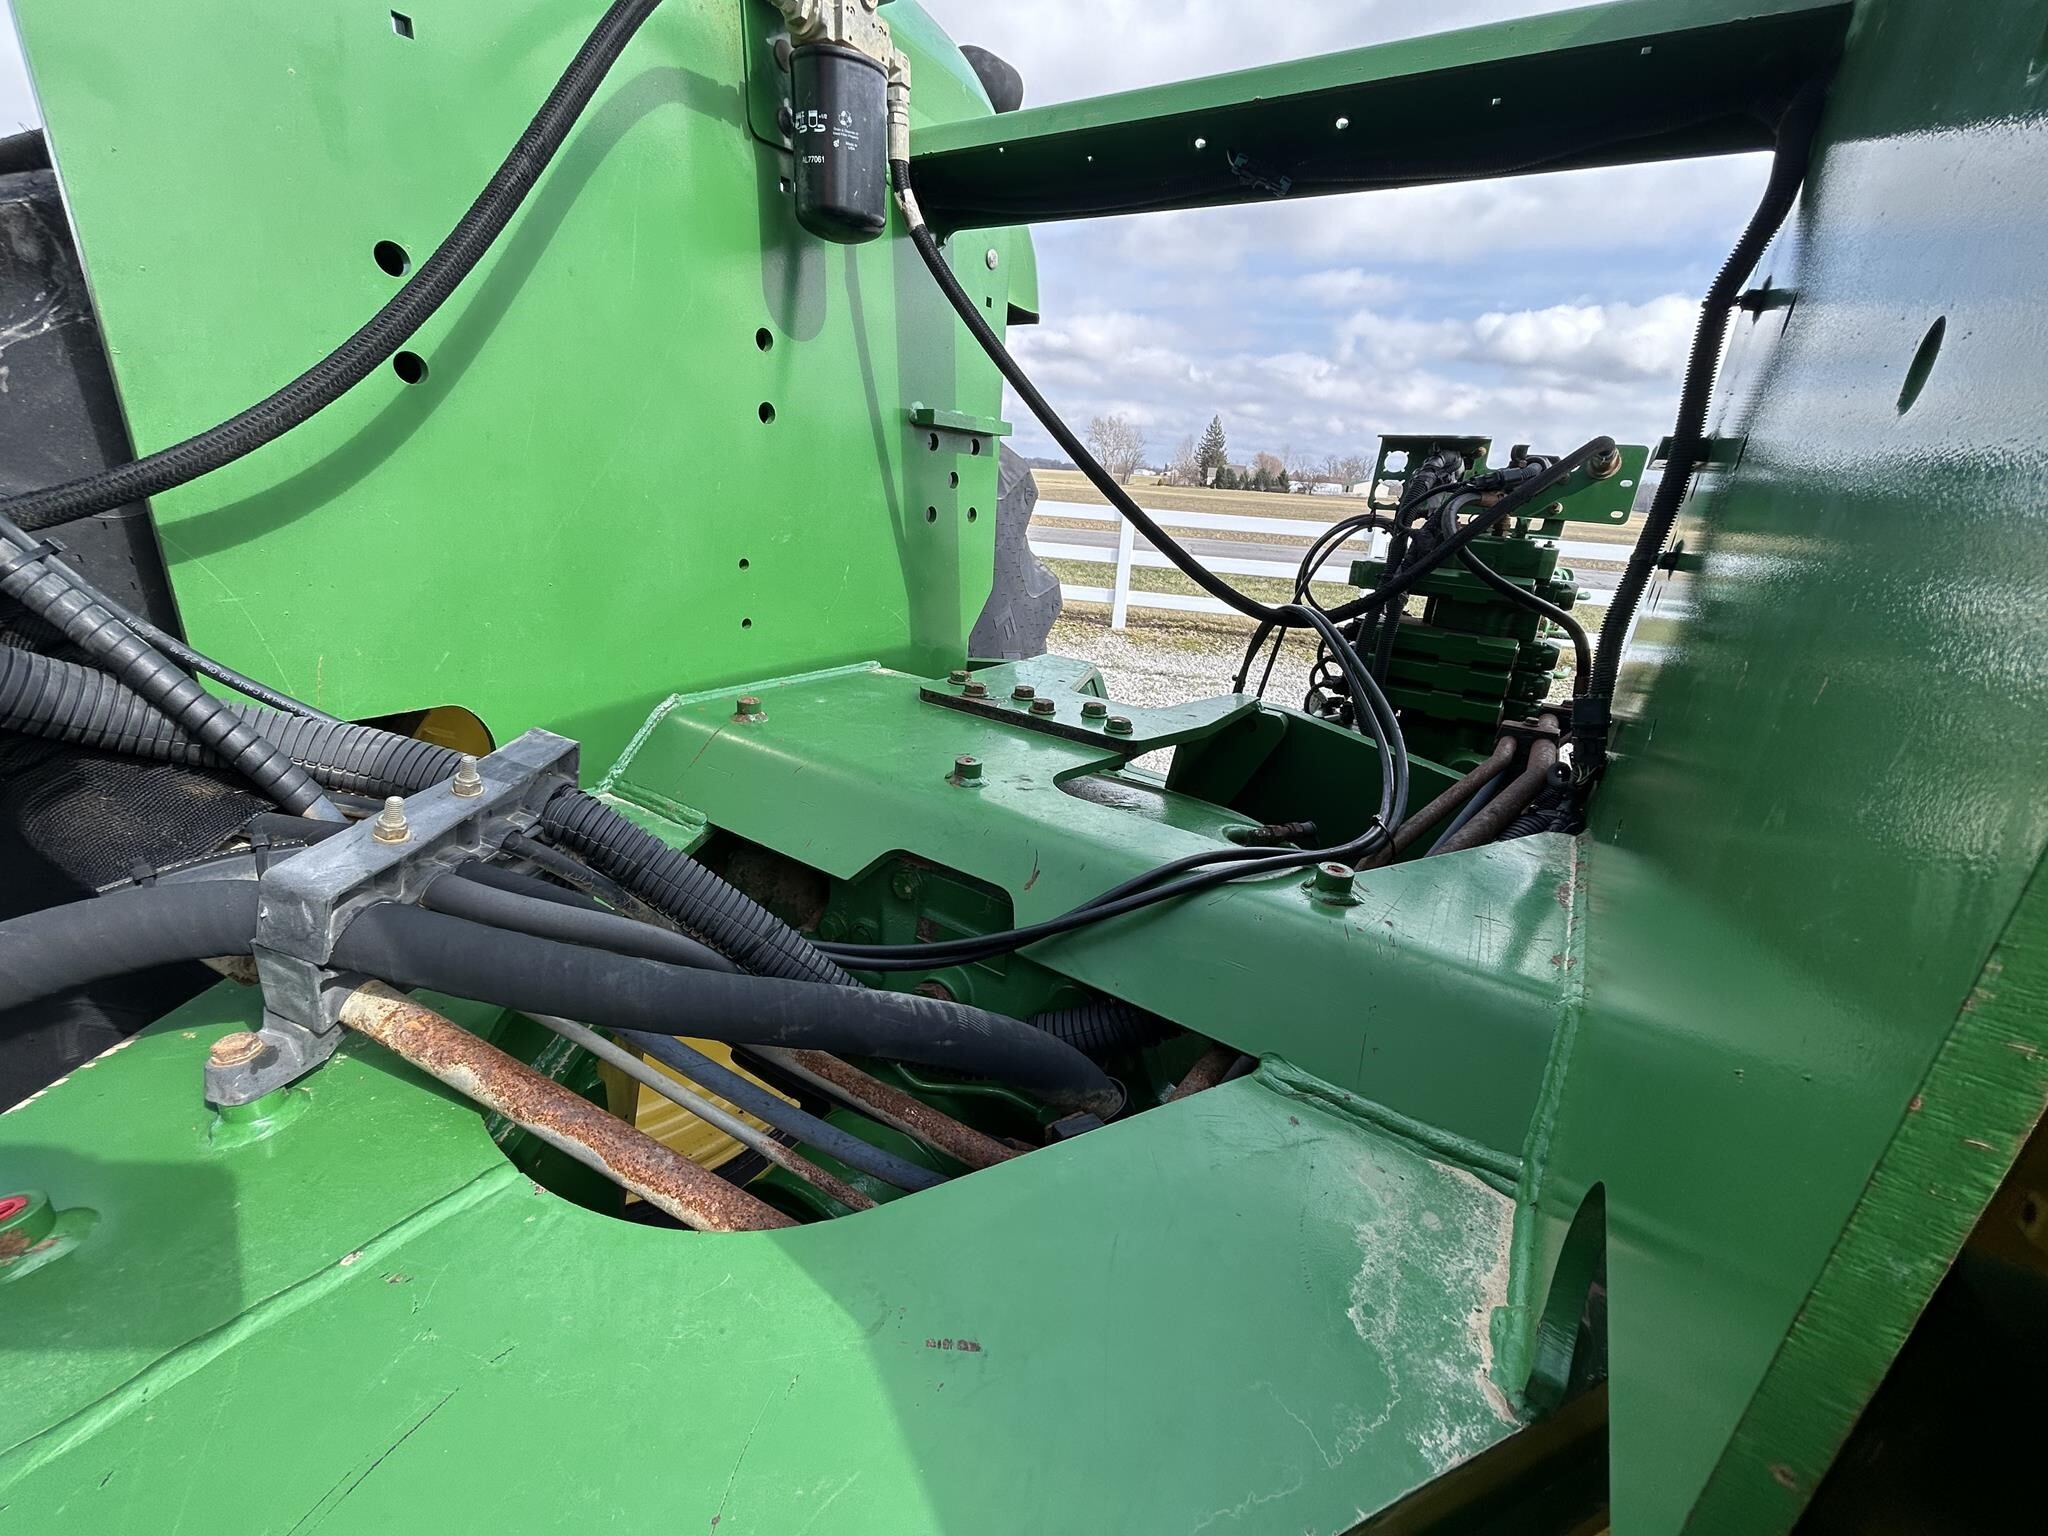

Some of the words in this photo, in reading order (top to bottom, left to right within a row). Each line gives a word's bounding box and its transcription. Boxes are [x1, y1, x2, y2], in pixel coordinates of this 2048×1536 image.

[200, 661, 218, 675] Ohm
[219, 672, 232, 682] 50
[233, 679, 261, 696] Cable
[261, 692, 298, 712] Coaxial
